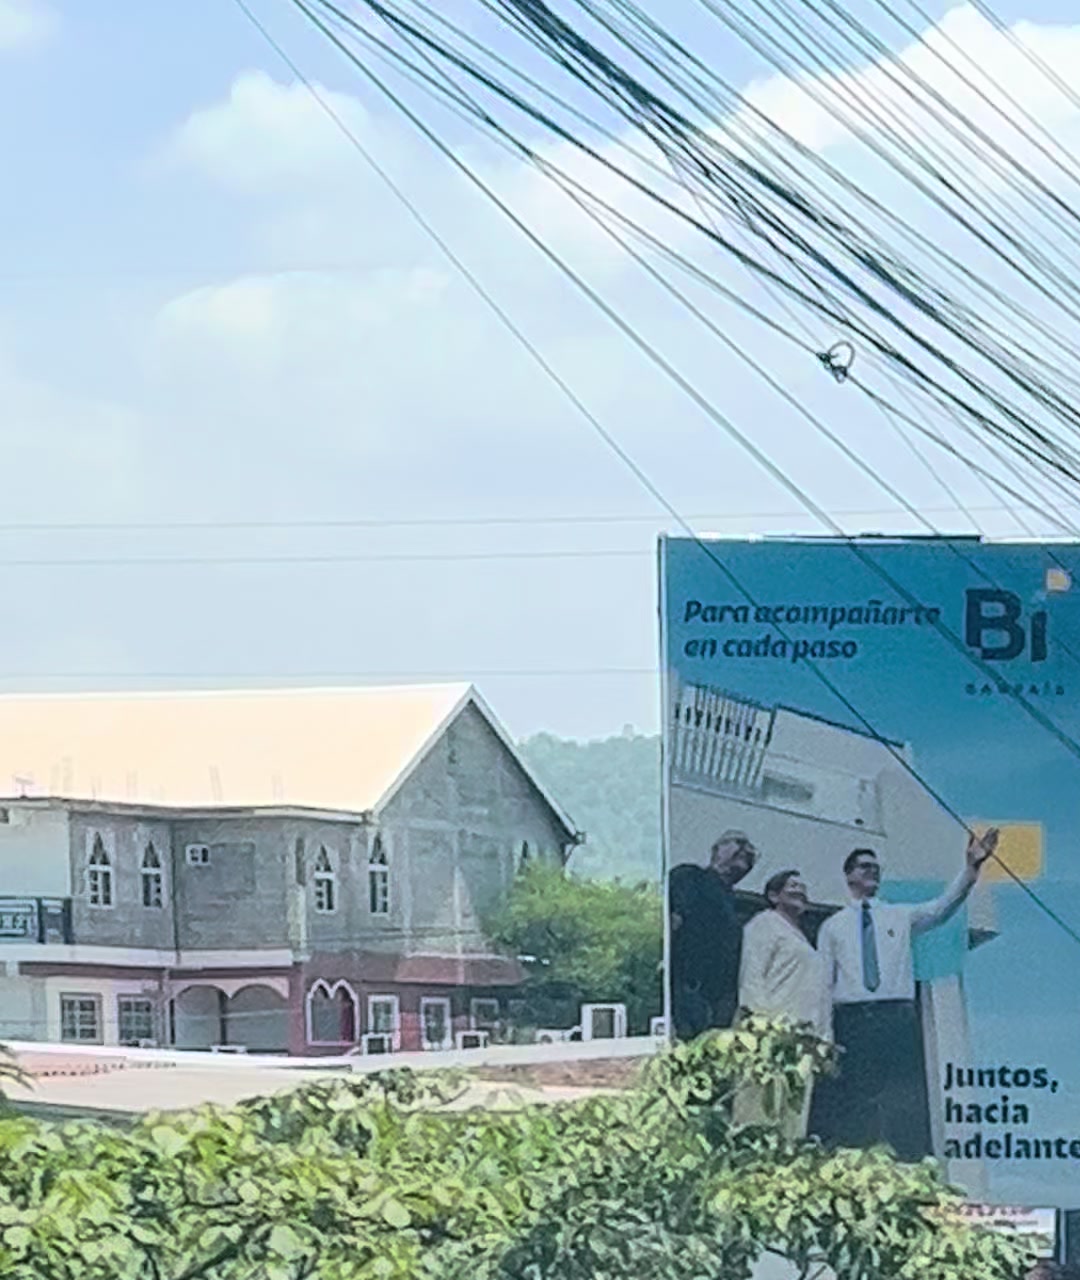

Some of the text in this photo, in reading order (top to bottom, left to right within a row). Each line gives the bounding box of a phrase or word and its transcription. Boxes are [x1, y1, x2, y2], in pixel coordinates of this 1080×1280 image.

[684, 599, 941, 631] Para acompañarte
[684, 634, 858, 663] en cada paso
[944, 1063, 1058, 1093] Juntos,
[945, 1095, 1029, 1124] hacia
